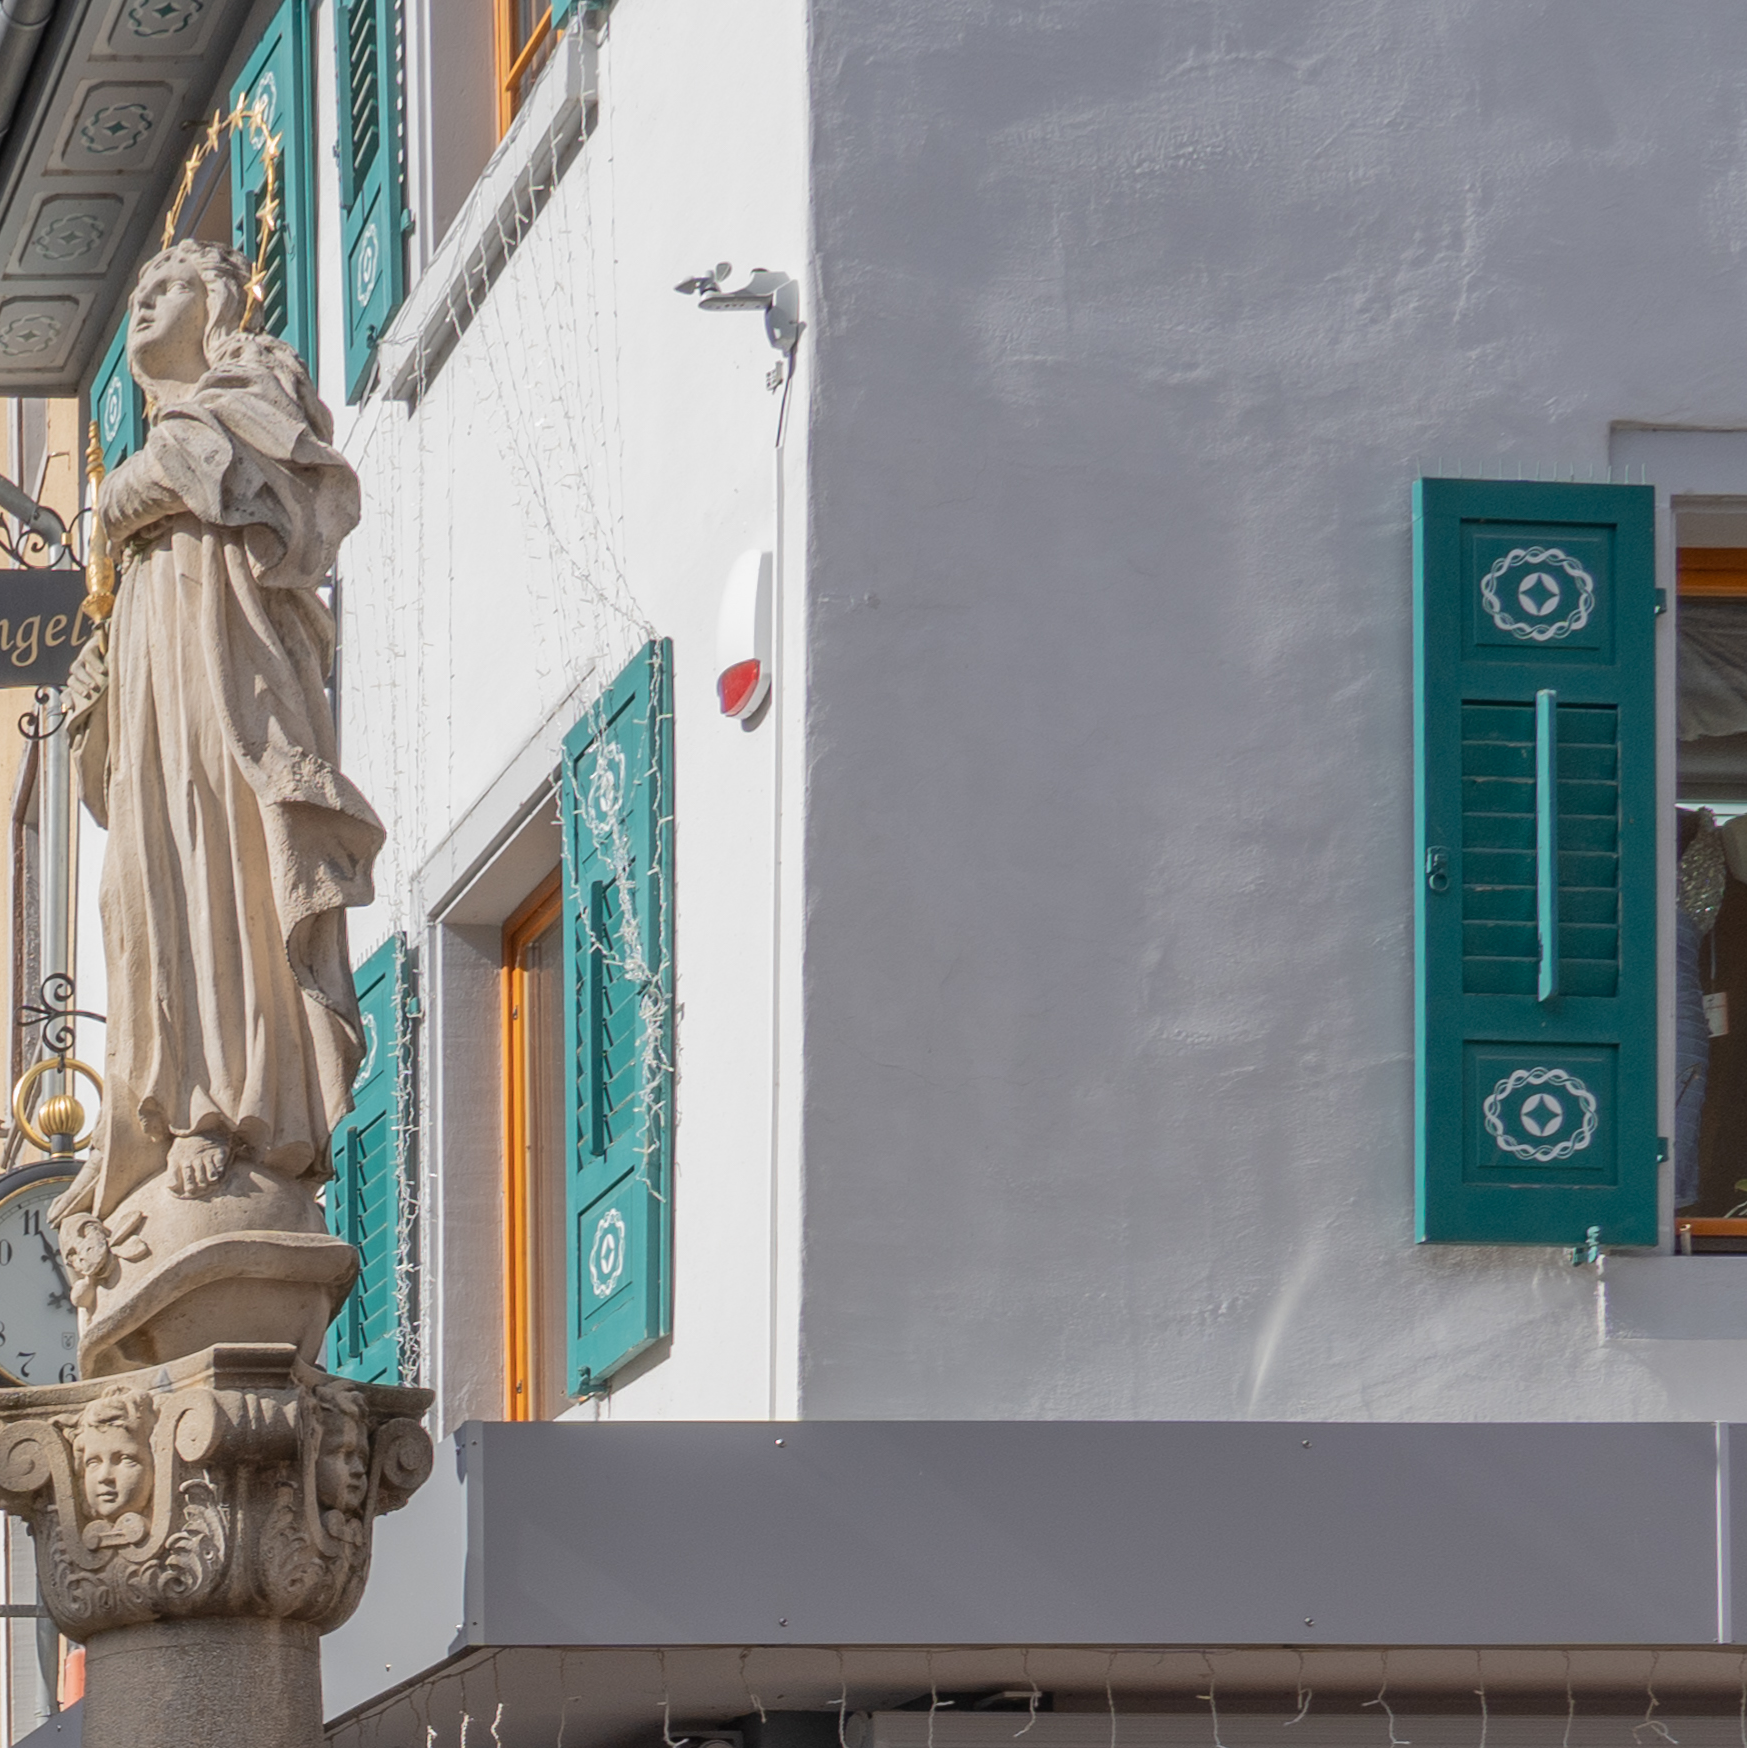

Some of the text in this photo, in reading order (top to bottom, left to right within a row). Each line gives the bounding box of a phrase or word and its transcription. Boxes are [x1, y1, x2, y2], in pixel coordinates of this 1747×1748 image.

[20, 1209, 41, 1236] 11
[16, 1351, 36, 1378] 7
[58, 1362, 77, 1384] 6
